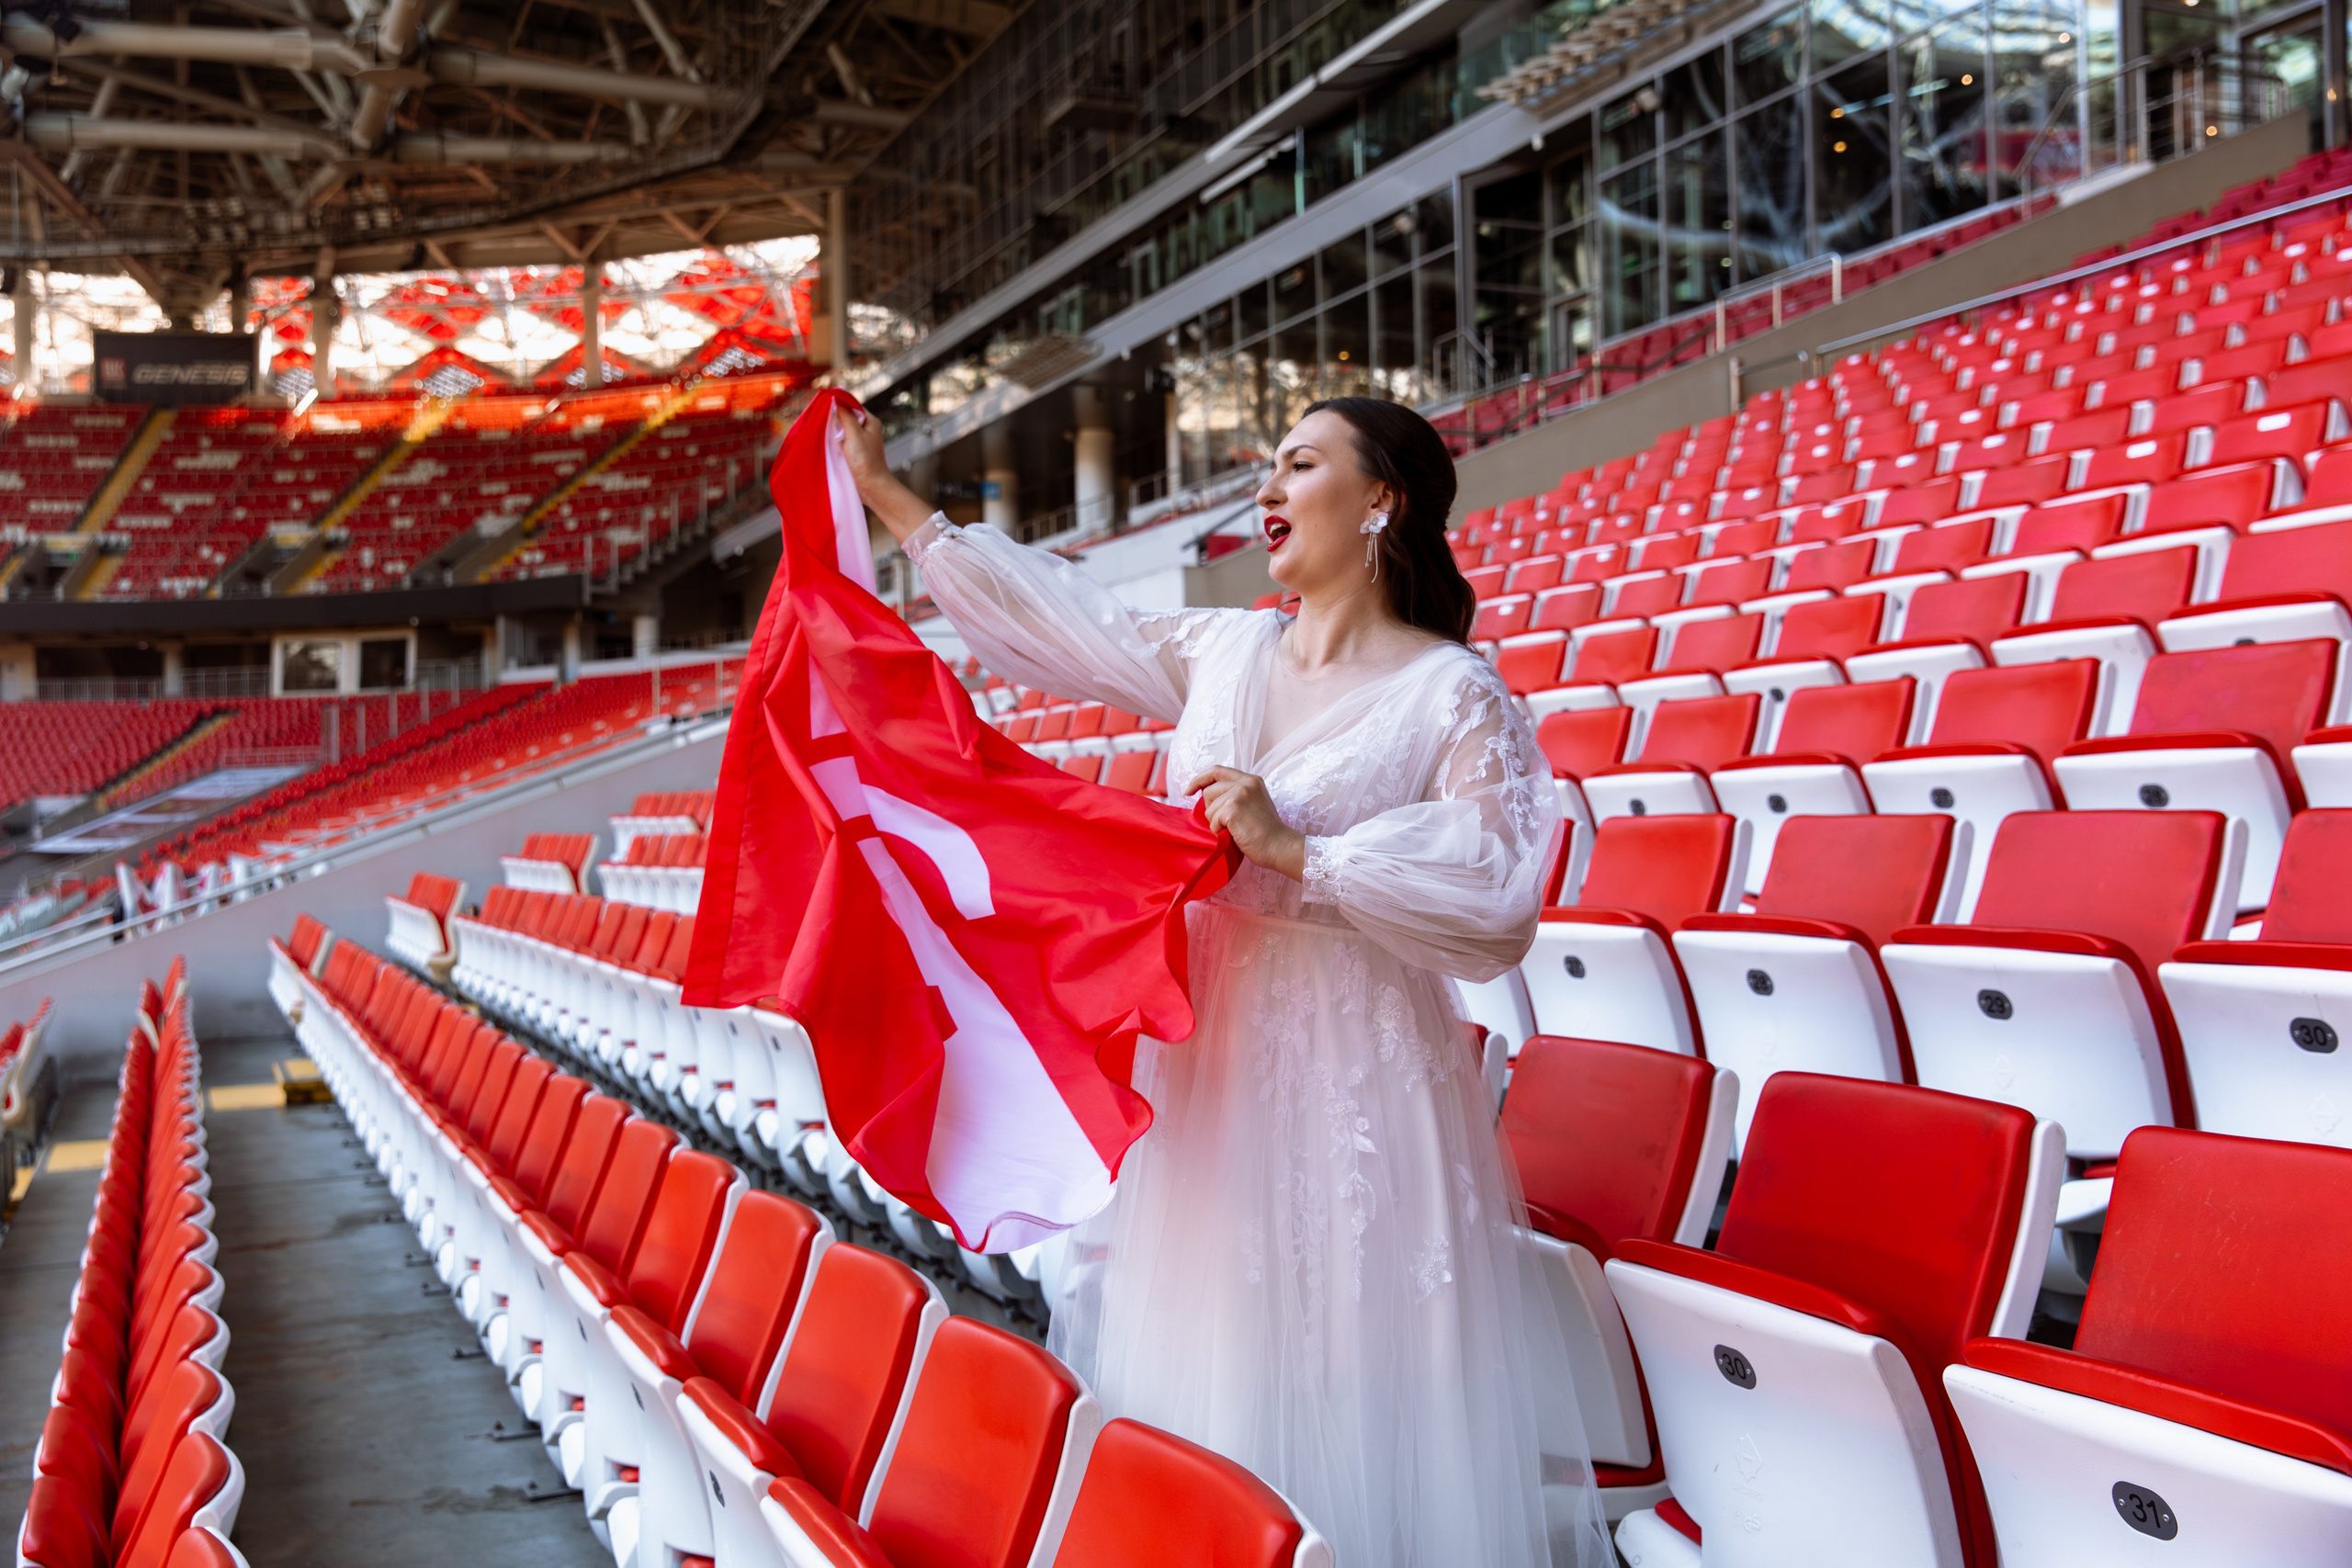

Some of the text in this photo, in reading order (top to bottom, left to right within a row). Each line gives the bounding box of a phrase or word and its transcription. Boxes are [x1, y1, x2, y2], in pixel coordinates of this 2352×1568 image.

[132, 363, 250, 385] GENESIS
[1984, 995, 2005, 1014] 29
[2299, 1024, 2327, 1046] 30
[1722, 1353, 1747, 1380] 30
[2129, 1494, 2161, 1529] 31
